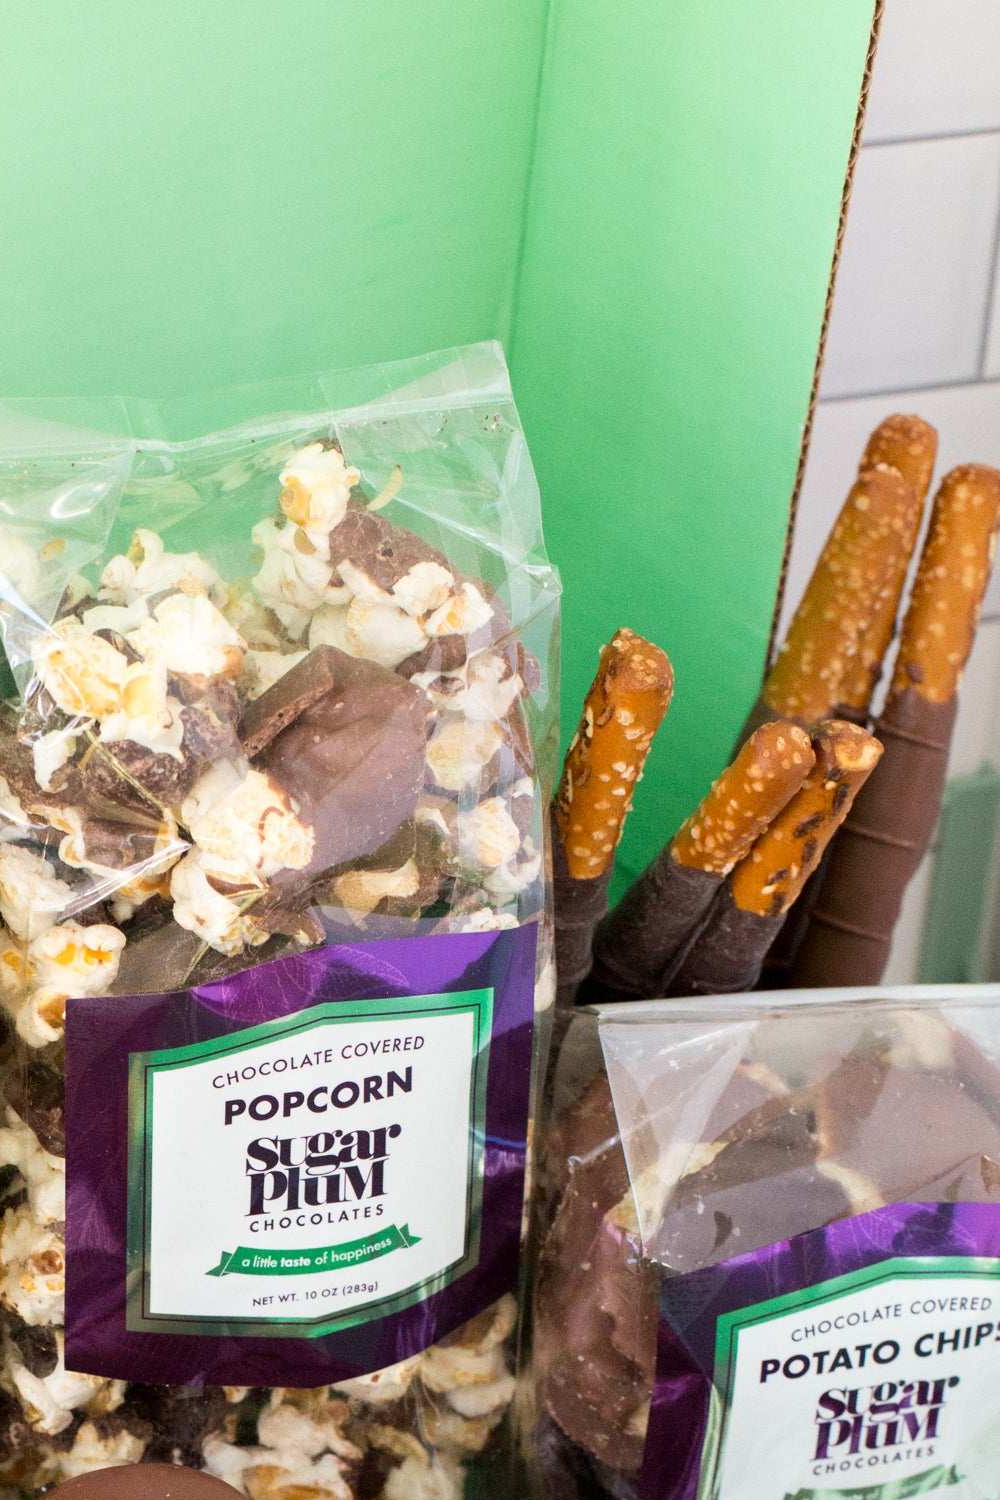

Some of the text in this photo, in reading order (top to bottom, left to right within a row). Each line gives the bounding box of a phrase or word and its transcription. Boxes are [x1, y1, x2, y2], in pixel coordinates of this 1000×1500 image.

[212, 1035, 425, 1089] CHOCOLATE COVERED
[224, 1066, 413, 1125] POPCORN
[249, 1204, 385, 1233] CHOCOLATES
[241, 1237, 392, 1268] a little taste of happiness
[252, 1295, 273, 1307] NET
[305, 1291, 317, 1300] 10
[321, 1288, 338, 1298] OZ
[342, 1281, 378, 1296] (283g)
[791, 1297, 993, 1342] CHOCOLATE COVERED
[759, 1340, 900, 1384] POTATO
[812, 1445, 936, 1476] CHOCOLATES
